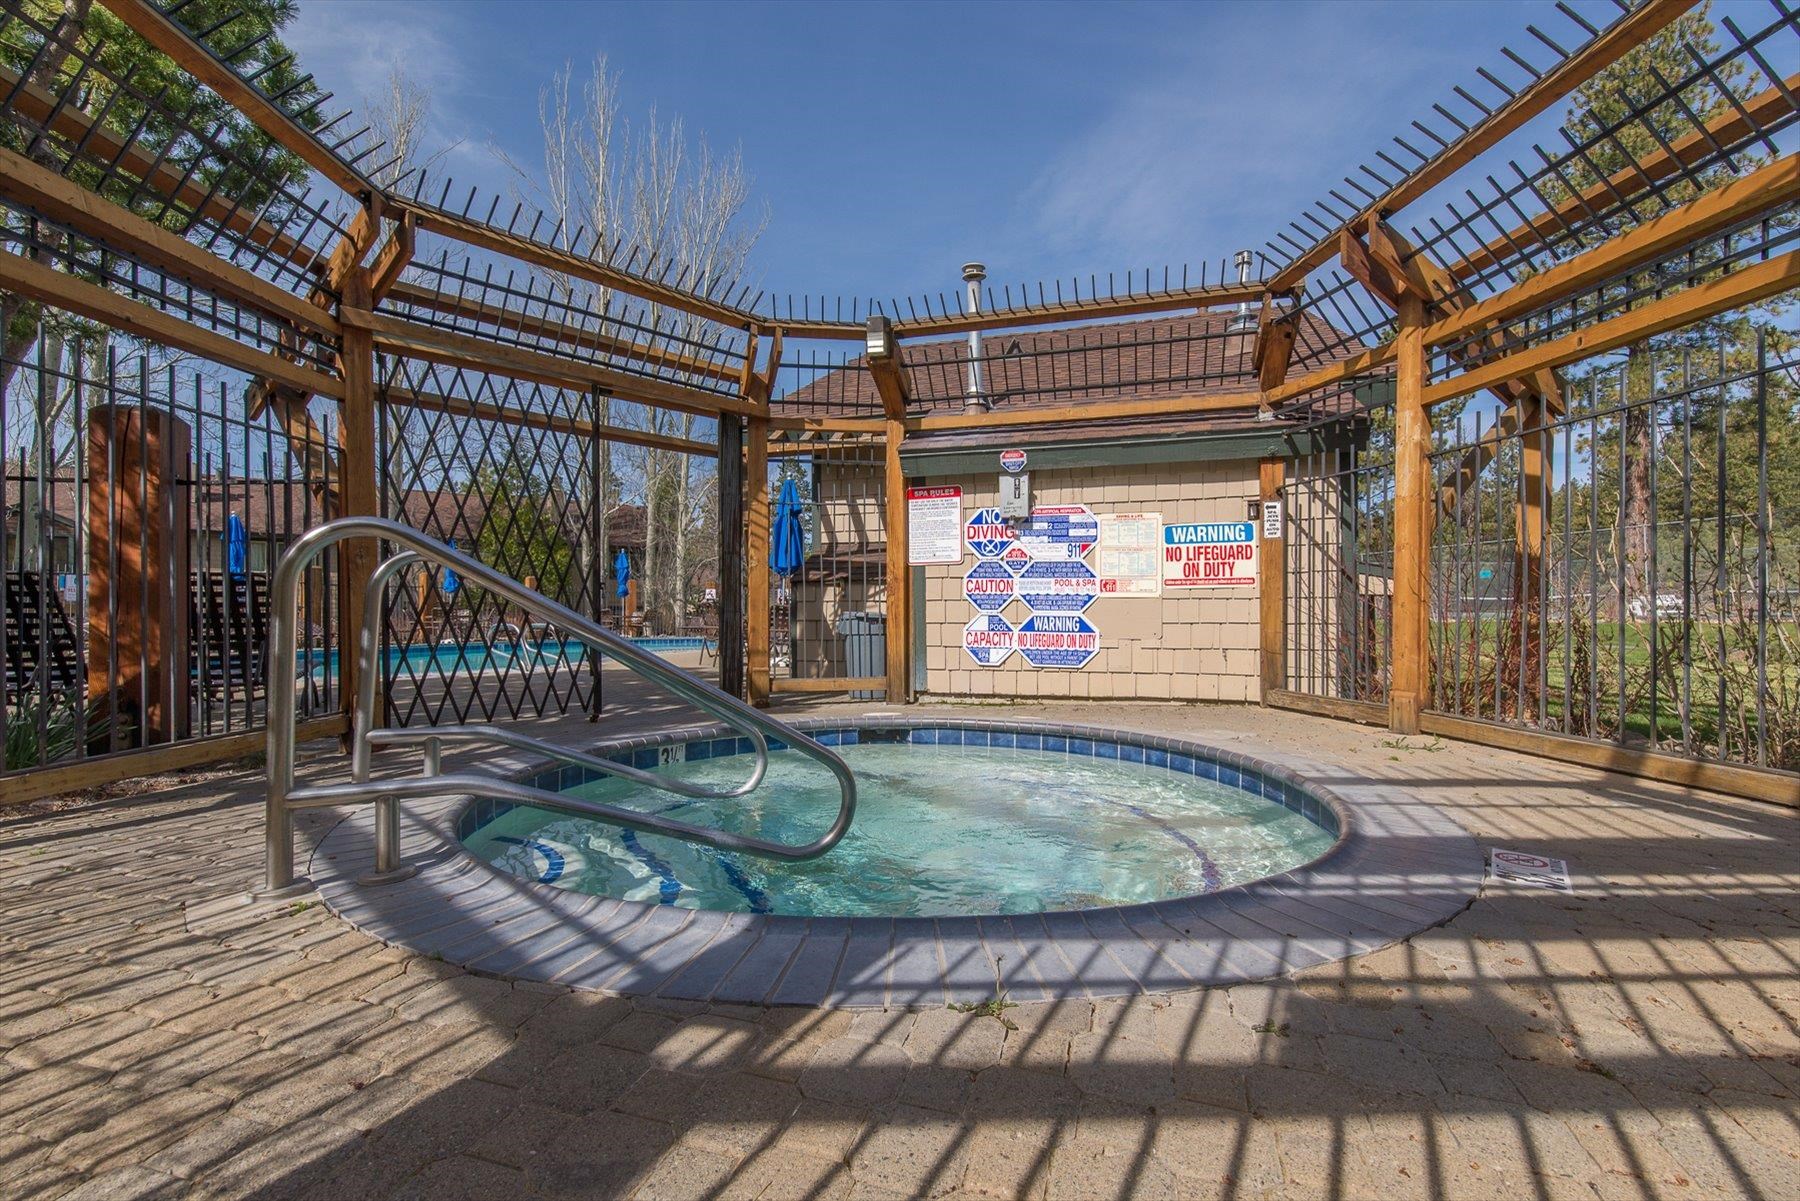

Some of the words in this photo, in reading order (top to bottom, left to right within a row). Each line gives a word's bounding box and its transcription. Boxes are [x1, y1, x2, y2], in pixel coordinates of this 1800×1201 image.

[930, 489, 954, 497] RULES
[982, 509, 1002, 524] NO
[967, 525, 1015, 540] DIVING
[1172, 524, 1246, 543] WARNING
[1068, 544, 1081, 558] 911
[1165, 546, 1182, 562] NO
[1186, 544, 1253, 562] LIFEGUARD
[1183, 562, 1200, 578] ON
[1204, 562, 1236, 578] DUTY
[966, 580, 1014, 592] CAUTION
[1034, 616, 1080, 632] WARNING
[966, 632, 1014, 646] CAPACITY
[1018, 633, 1028, 647] NO
[1029, 634, 1064, 648] LIFEGUARD
[1066, 634, 1077, 648] ON
[1079, 634, 1096, 648] DUTY
